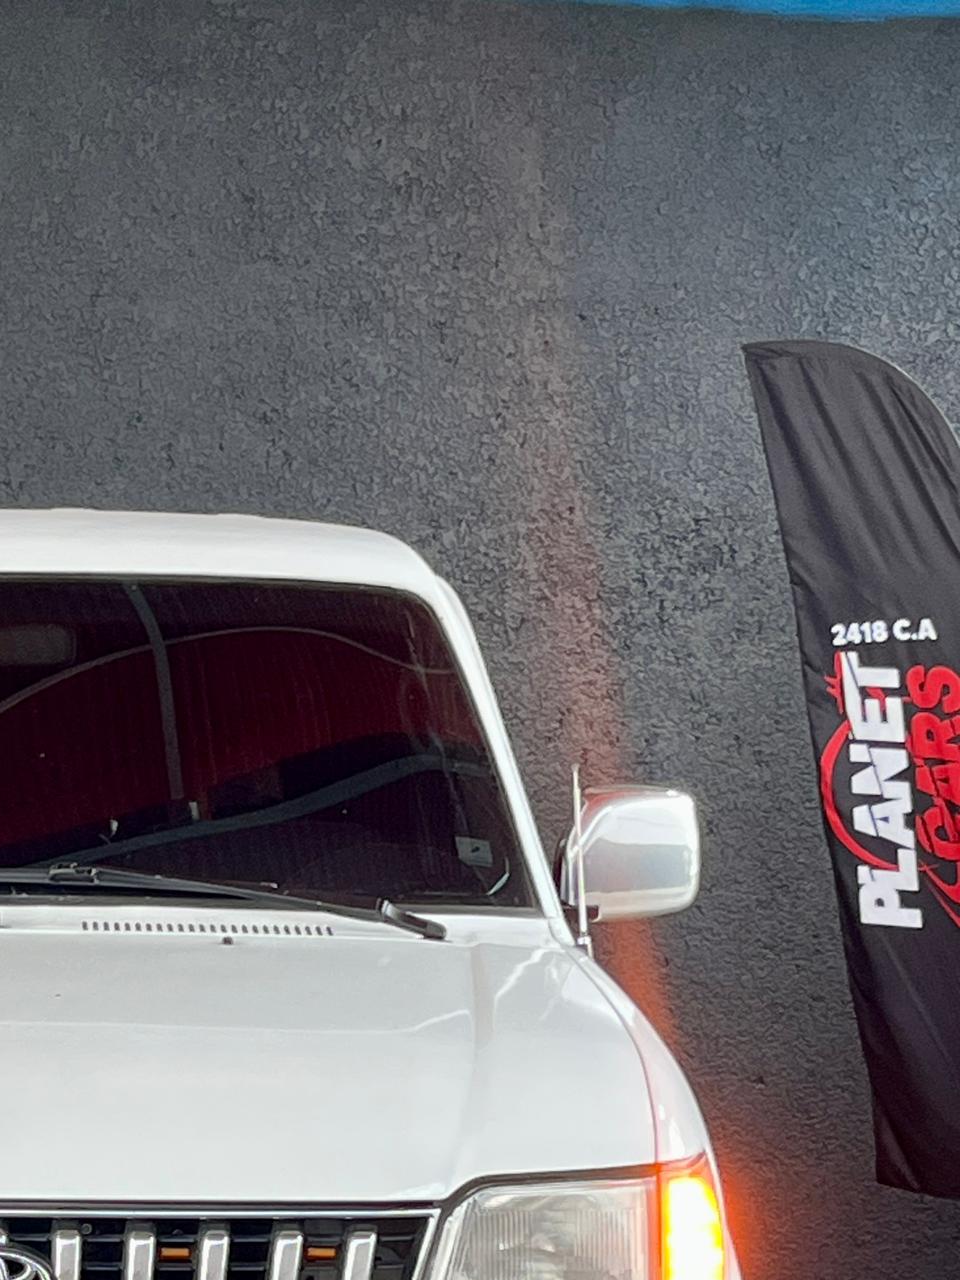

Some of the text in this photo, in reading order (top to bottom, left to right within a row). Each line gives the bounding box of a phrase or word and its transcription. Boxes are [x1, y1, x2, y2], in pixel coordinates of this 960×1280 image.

[831, 618, 937, 646] 2418 C.A
[840, 651, 923, 928] PLANET
